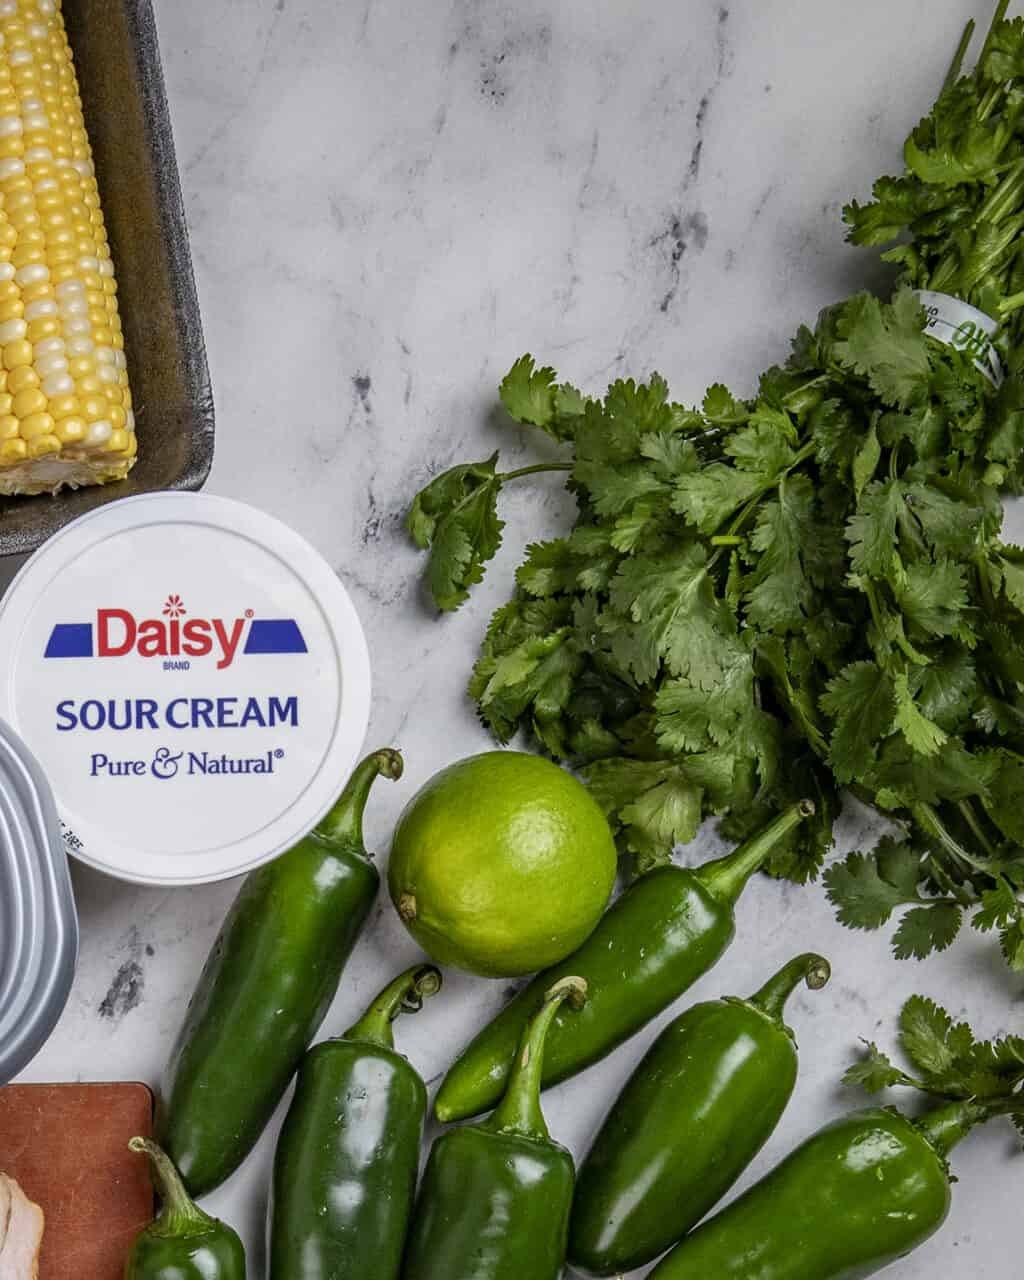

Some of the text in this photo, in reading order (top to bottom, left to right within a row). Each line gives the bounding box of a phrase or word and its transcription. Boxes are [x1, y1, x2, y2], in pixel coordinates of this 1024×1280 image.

[163, 661, 190, 670] BRAND
[56, 696, 299, 731] SOUR CREAM
[90, 753, 146, 777] Pure
[151, 747, 184, 780] &
